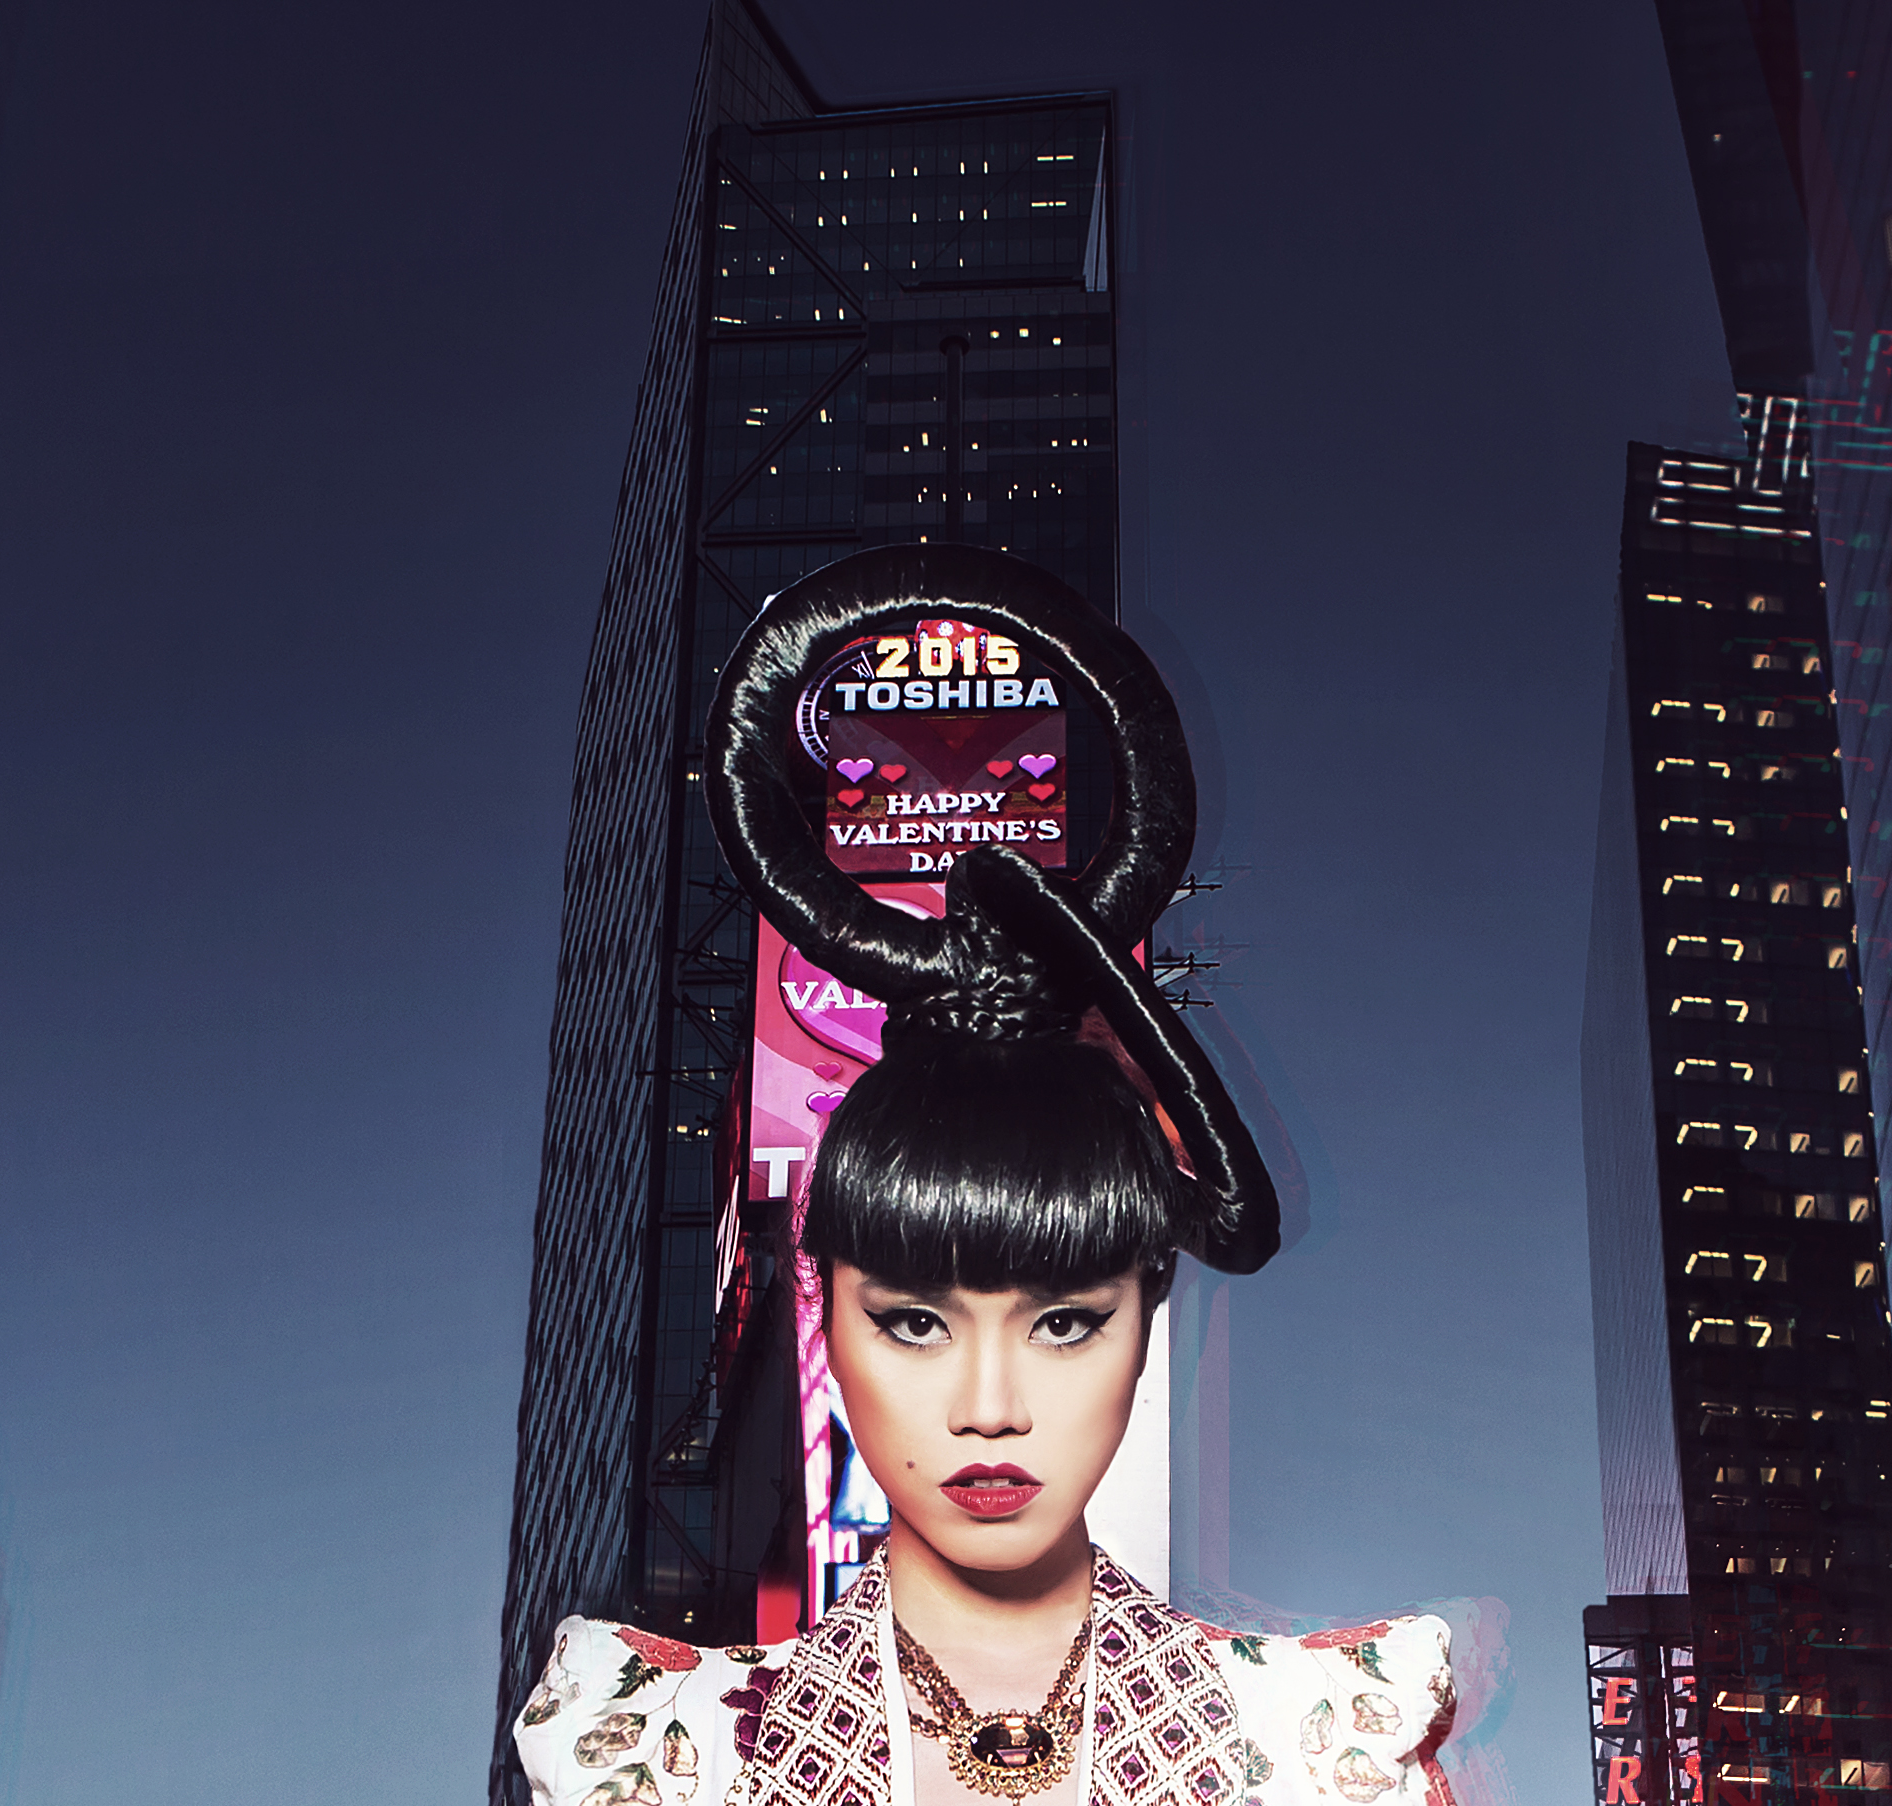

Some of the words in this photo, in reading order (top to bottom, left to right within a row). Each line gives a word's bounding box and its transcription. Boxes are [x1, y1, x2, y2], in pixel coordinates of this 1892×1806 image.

[875, 637, 1021, 677] 2015
[835, 678, 1060, 711] TOSHIBA
[886, 792, 1006, 817] HAPPY
[829, 820, 1062, 846] VALENTINE'S
